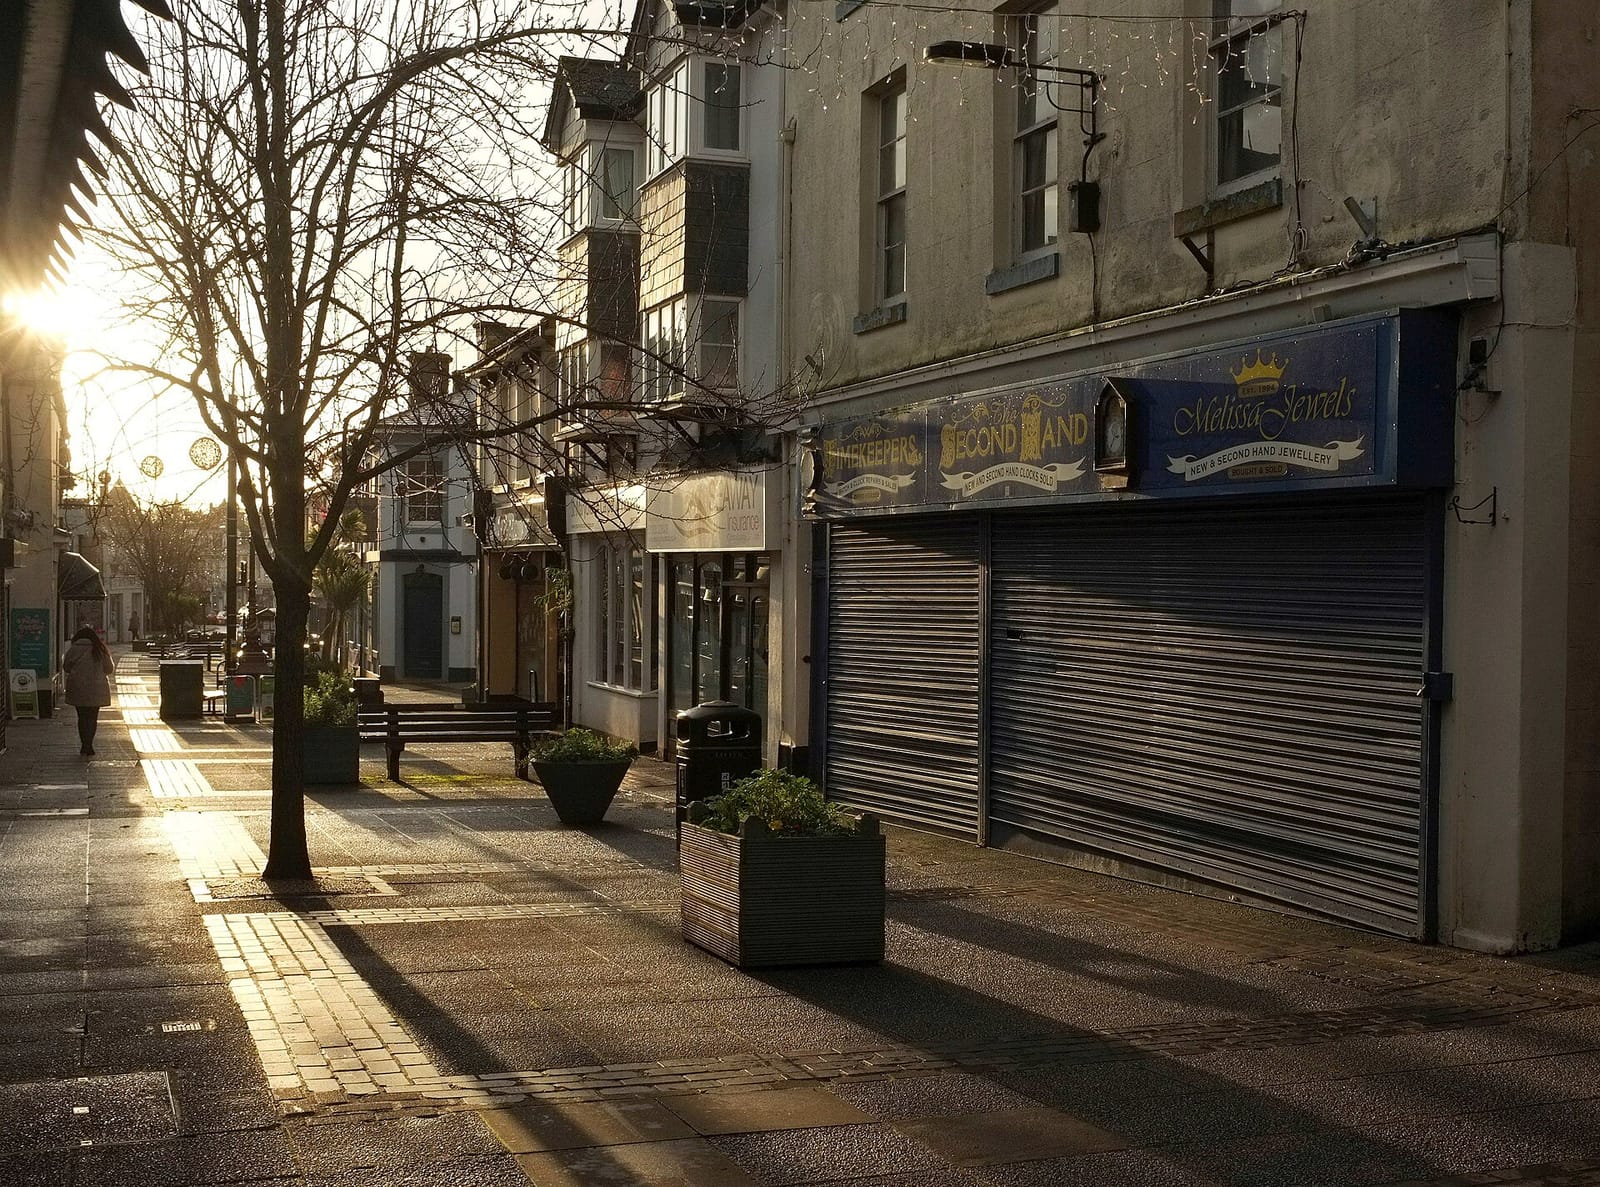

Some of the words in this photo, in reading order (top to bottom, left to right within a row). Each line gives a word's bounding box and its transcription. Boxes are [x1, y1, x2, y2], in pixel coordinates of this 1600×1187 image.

[1174, 395, 1264, 436] Melissa
[1260, 376, 1357, 441] Jewels
[823, 435, 921, 479] TIMEKEEPERS
[938, 423, 1017, 470] SECOND
[1019, 407, 1089, 462] HAND
[976, 475, 985, 487] AND
[986, 467, 1004, 482] SECOND
[1005, 466, 1018, 477] HAND
[1020, 467, 1039, 482] CLOCKS
[1040, 473, 1053, 487] SOLD
[1190, 462, 1208, 476] NEW
[1209, 459, 1216, 468] &
[1217, 448, 1250, 466] SECOND
[1252, 446, 1276, 457] HAND
[1278, 447, 1332, 465] JEWELLERY
[1231, 467, 1257, 476] BOUGHT
[1265, 465, 1283, 474] SOLD
